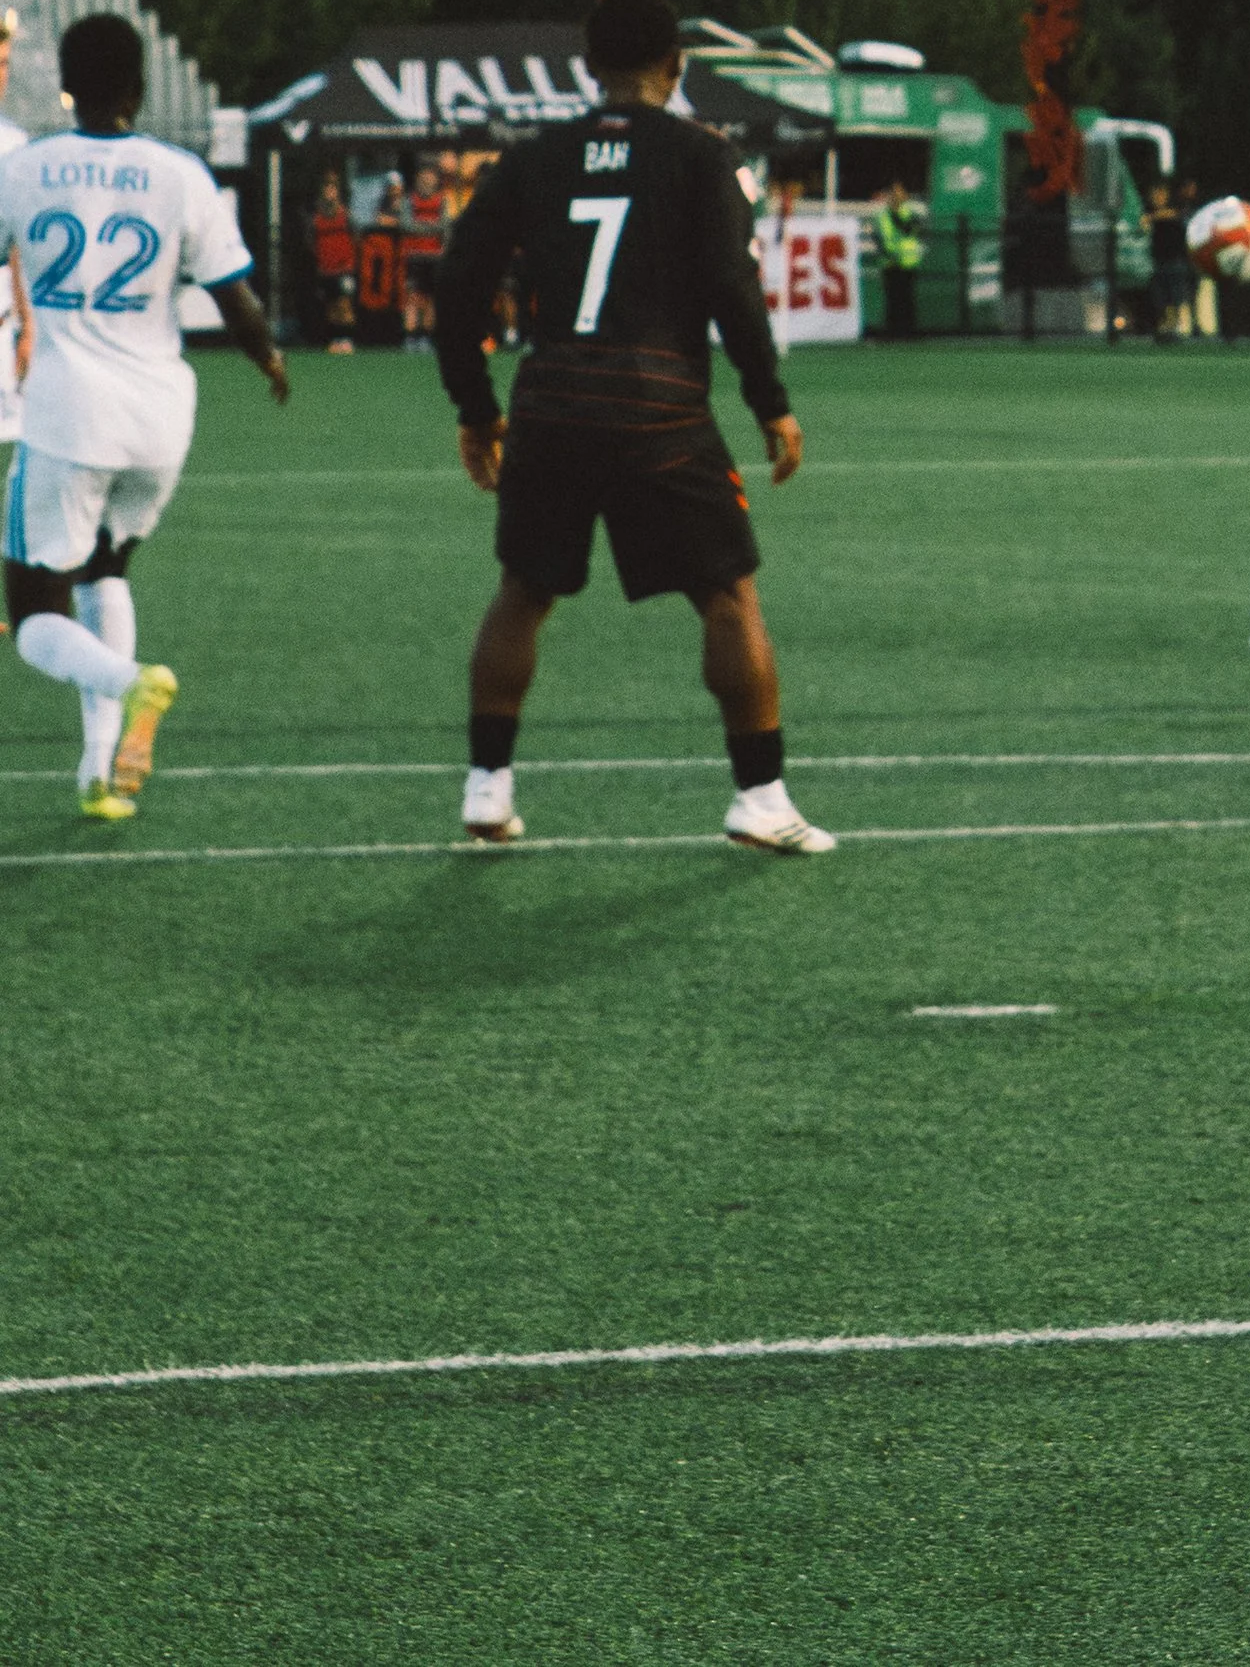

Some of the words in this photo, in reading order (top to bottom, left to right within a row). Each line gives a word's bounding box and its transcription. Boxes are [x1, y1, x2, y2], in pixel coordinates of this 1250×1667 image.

[584, 141, 630, 173] BAH
[28, 207, 161, 312] 22
[569, 197, 632, 333] 7
